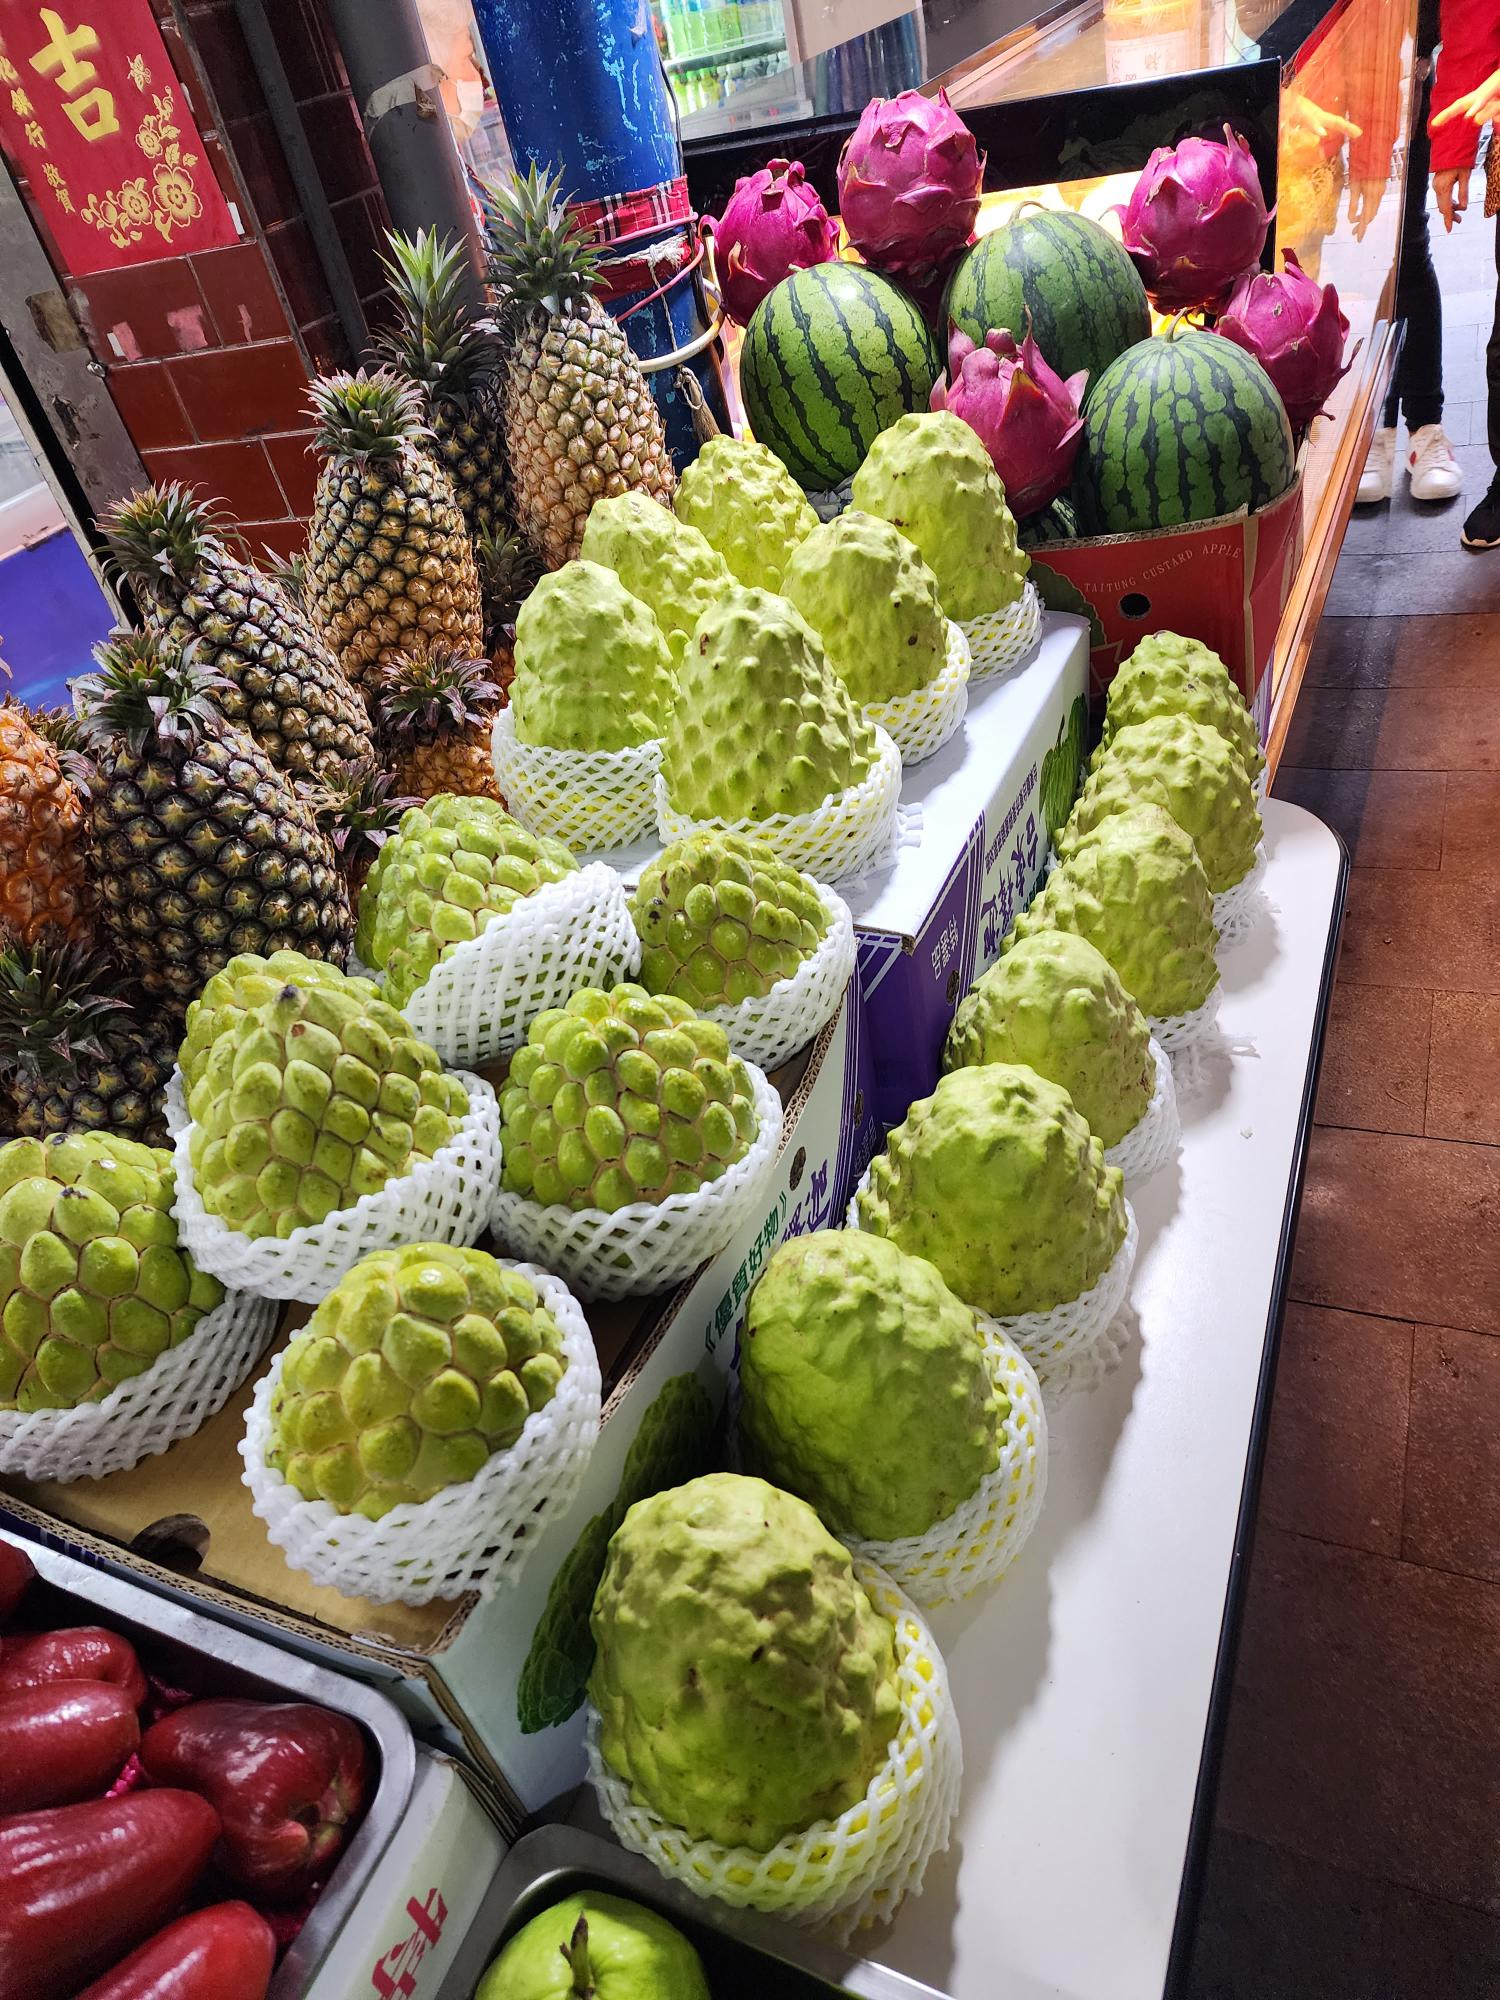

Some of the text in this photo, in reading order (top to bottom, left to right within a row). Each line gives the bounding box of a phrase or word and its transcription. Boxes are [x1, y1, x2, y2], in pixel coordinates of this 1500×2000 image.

[29, 8, 120, 142] 吉
[42, 163, 75, 214] 敬賀
[1084, 543, 1242, 593] TAITUNG CUSTARD APPLE
